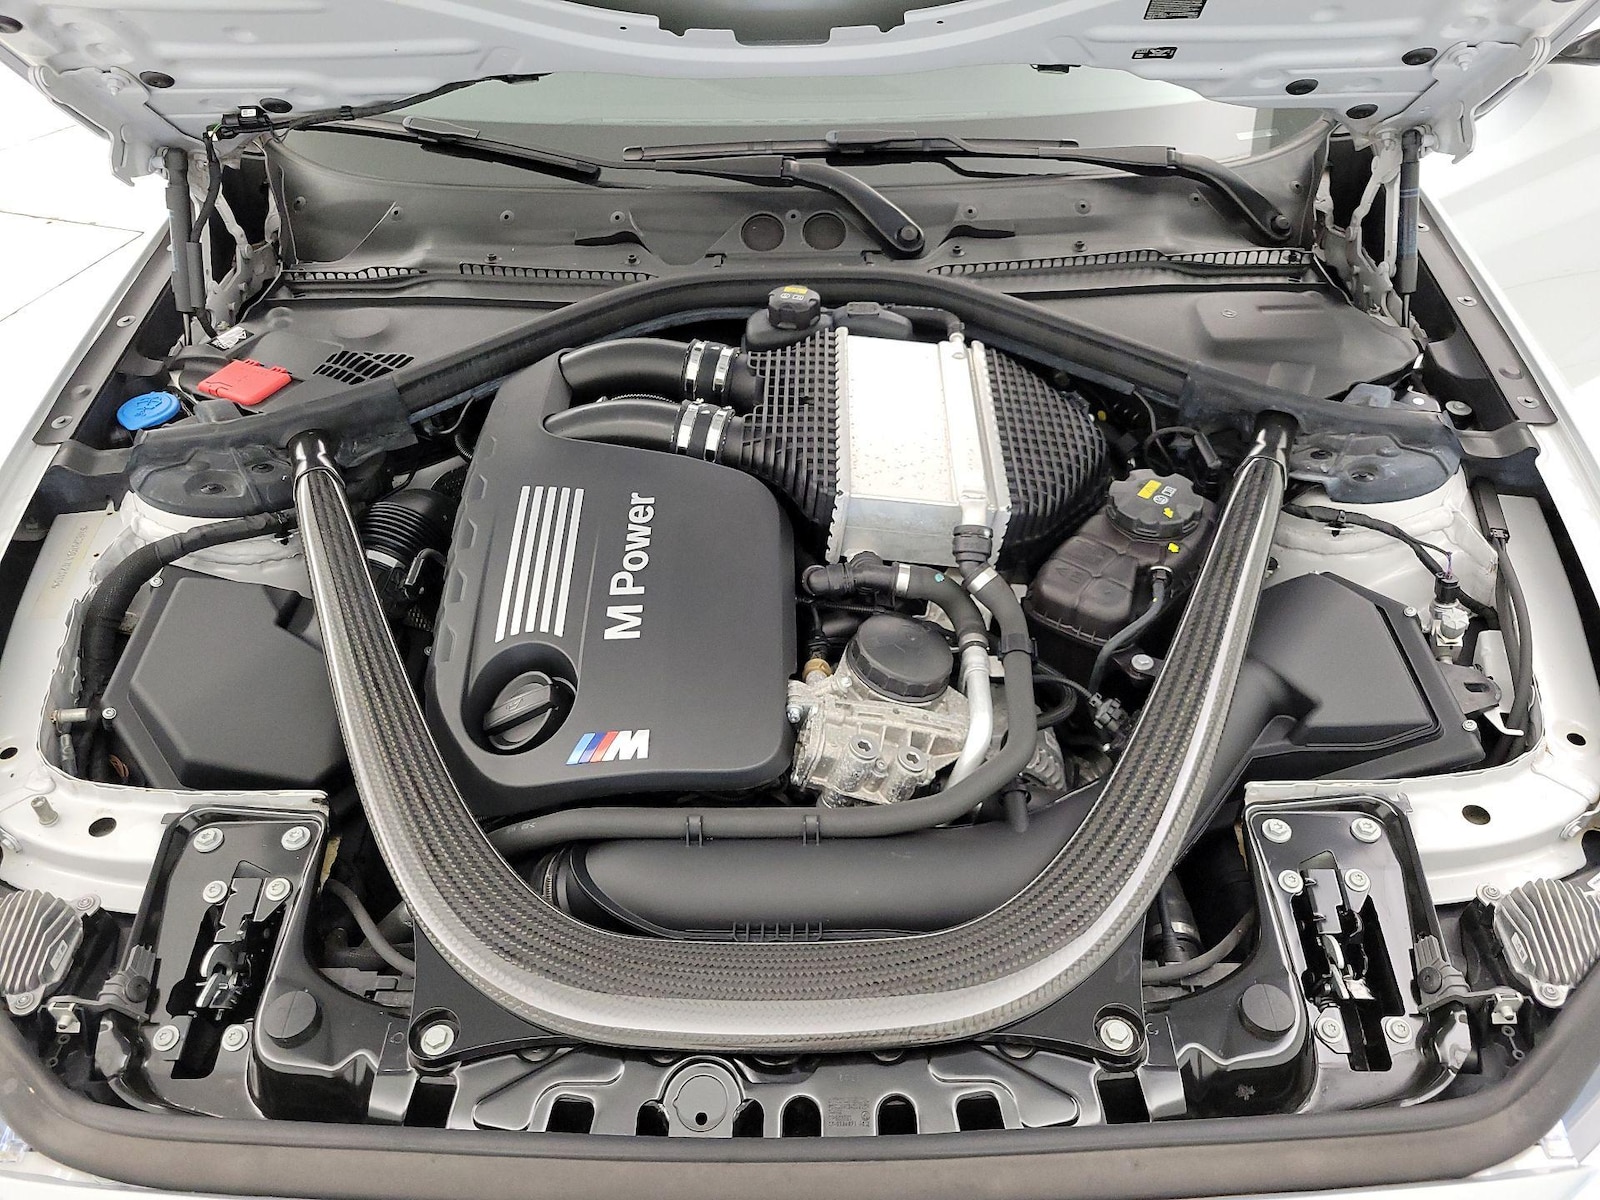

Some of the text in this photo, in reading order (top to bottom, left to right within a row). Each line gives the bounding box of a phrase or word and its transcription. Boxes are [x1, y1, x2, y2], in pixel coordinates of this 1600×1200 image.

[603, 492, 655, 640] M Power
[600, 729, 650, 762] M
